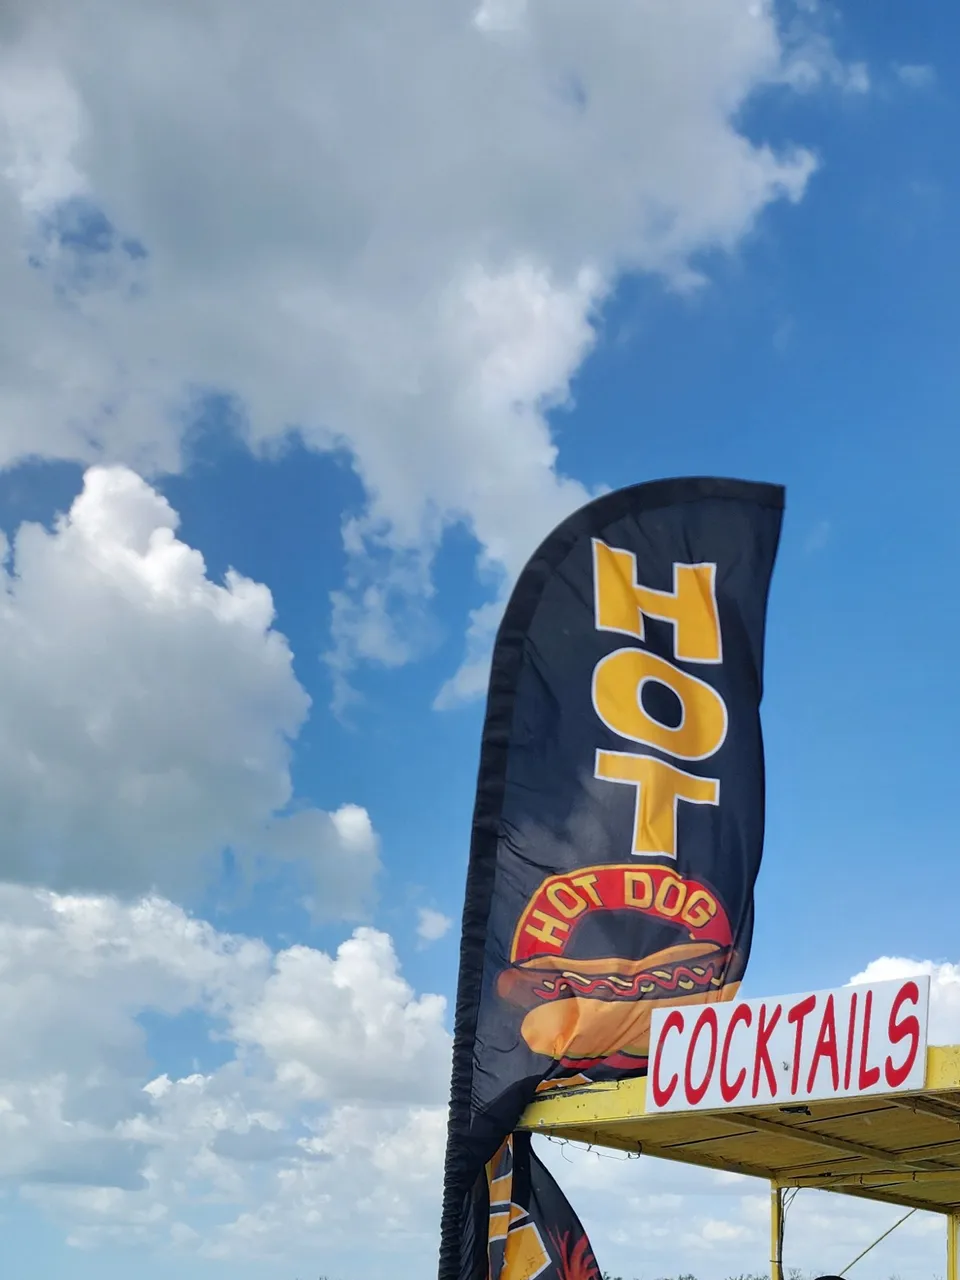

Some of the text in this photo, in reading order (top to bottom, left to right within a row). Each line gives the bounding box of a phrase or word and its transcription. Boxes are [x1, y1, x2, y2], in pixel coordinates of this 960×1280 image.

[591, 538, 729, 858] HOT
[525, 872, 718, 949] HOT DOG
[650, 980, 921, 1108] COCKTAILS
